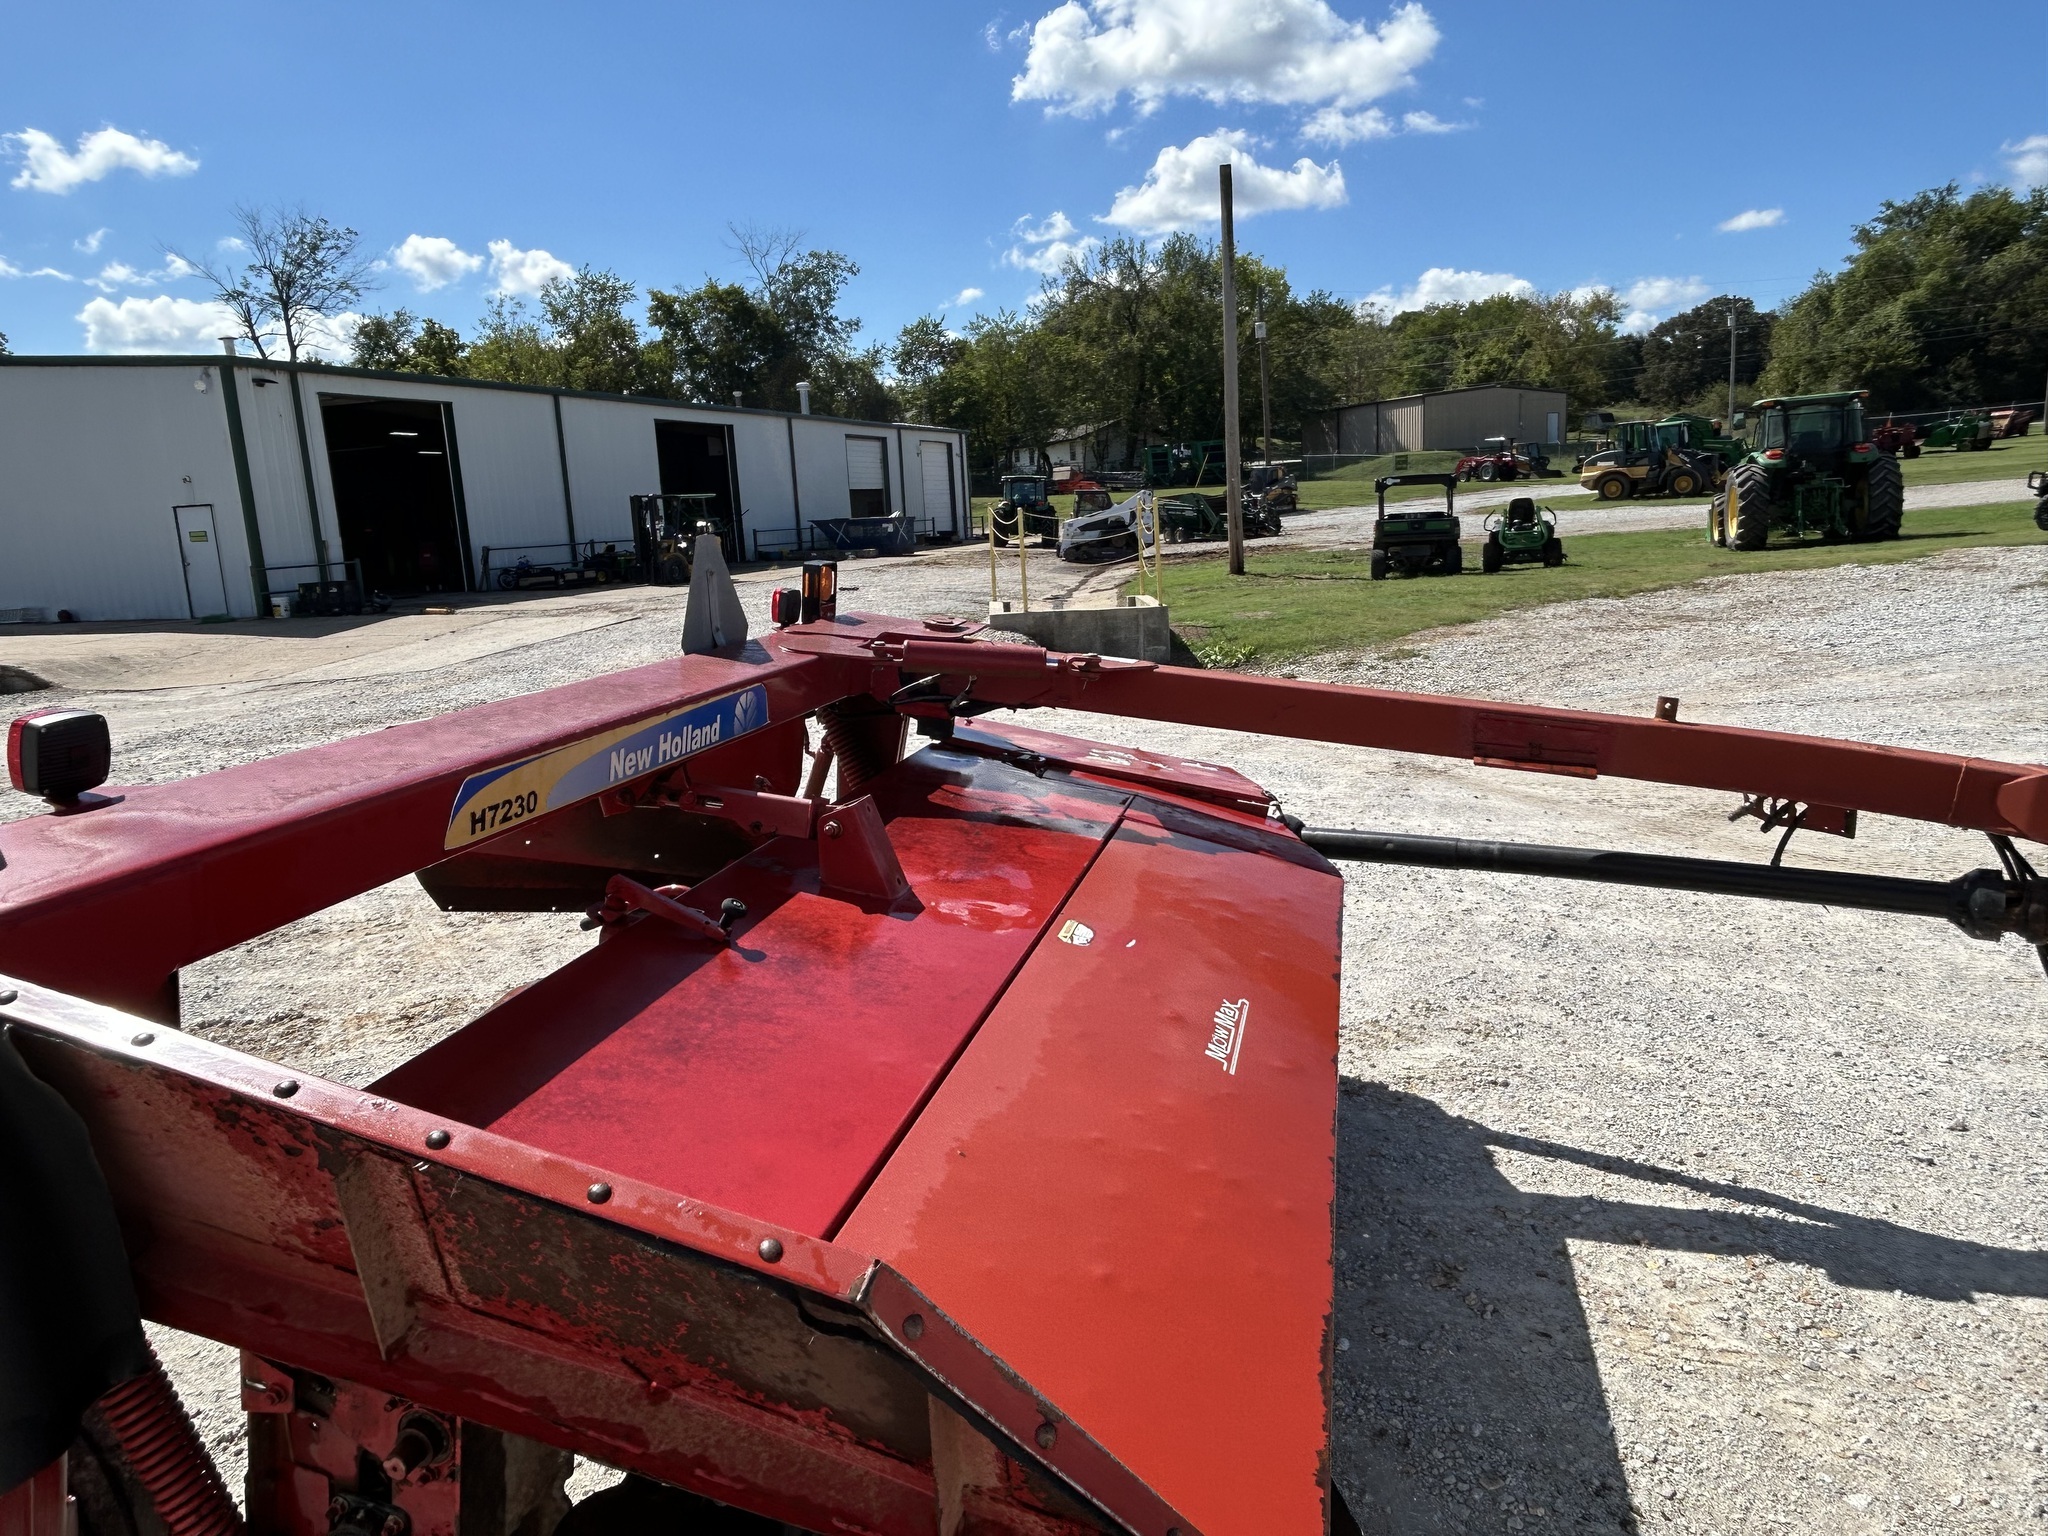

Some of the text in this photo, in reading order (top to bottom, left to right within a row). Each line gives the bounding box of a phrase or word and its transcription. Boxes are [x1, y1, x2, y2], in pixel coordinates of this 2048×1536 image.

[608, 714, 721, 782] New Holland
[470, 790, 538, 836] H7230
